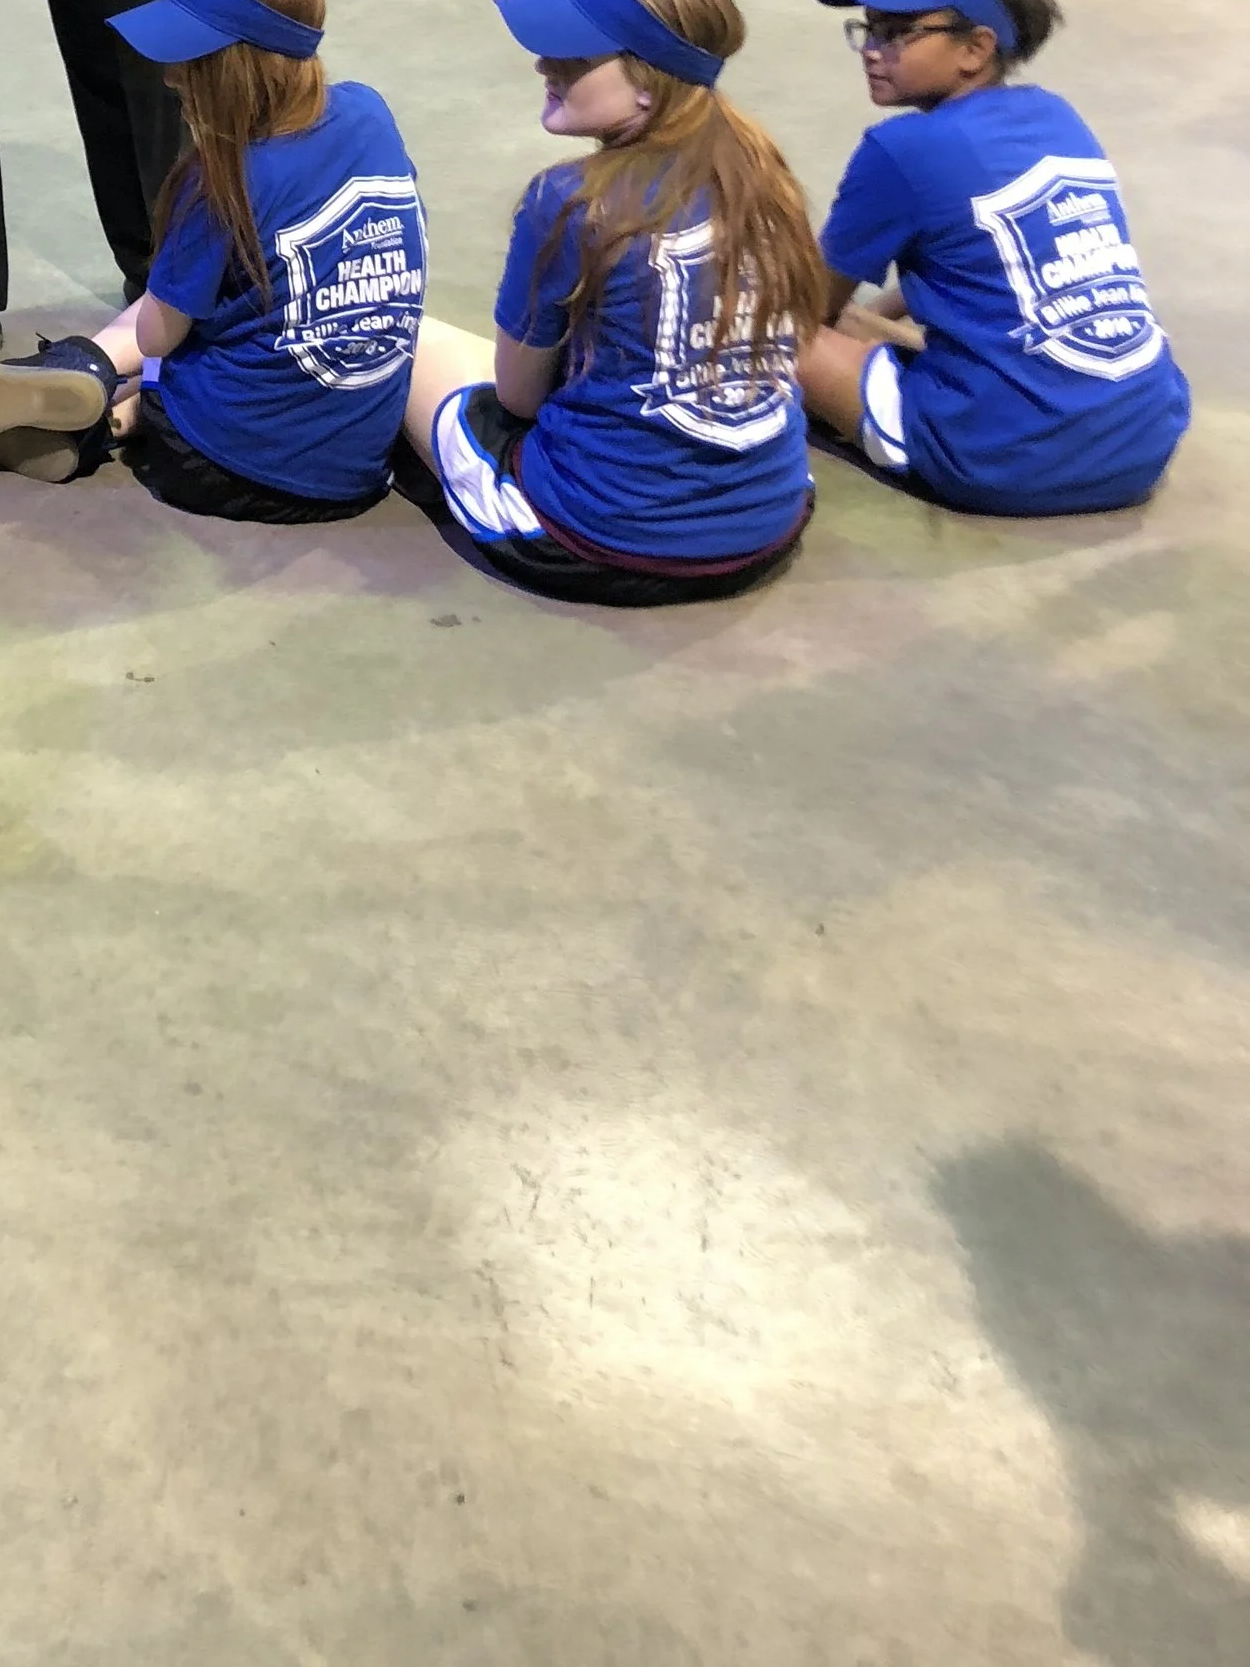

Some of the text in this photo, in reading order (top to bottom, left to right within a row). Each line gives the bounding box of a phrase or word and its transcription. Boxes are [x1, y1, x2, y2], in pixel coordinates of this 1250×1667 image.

[337, 249, 407, 283] HEALTH
[315, 268, 422, 311] CHAMPION
[351, 314, 395, 333] Jean
